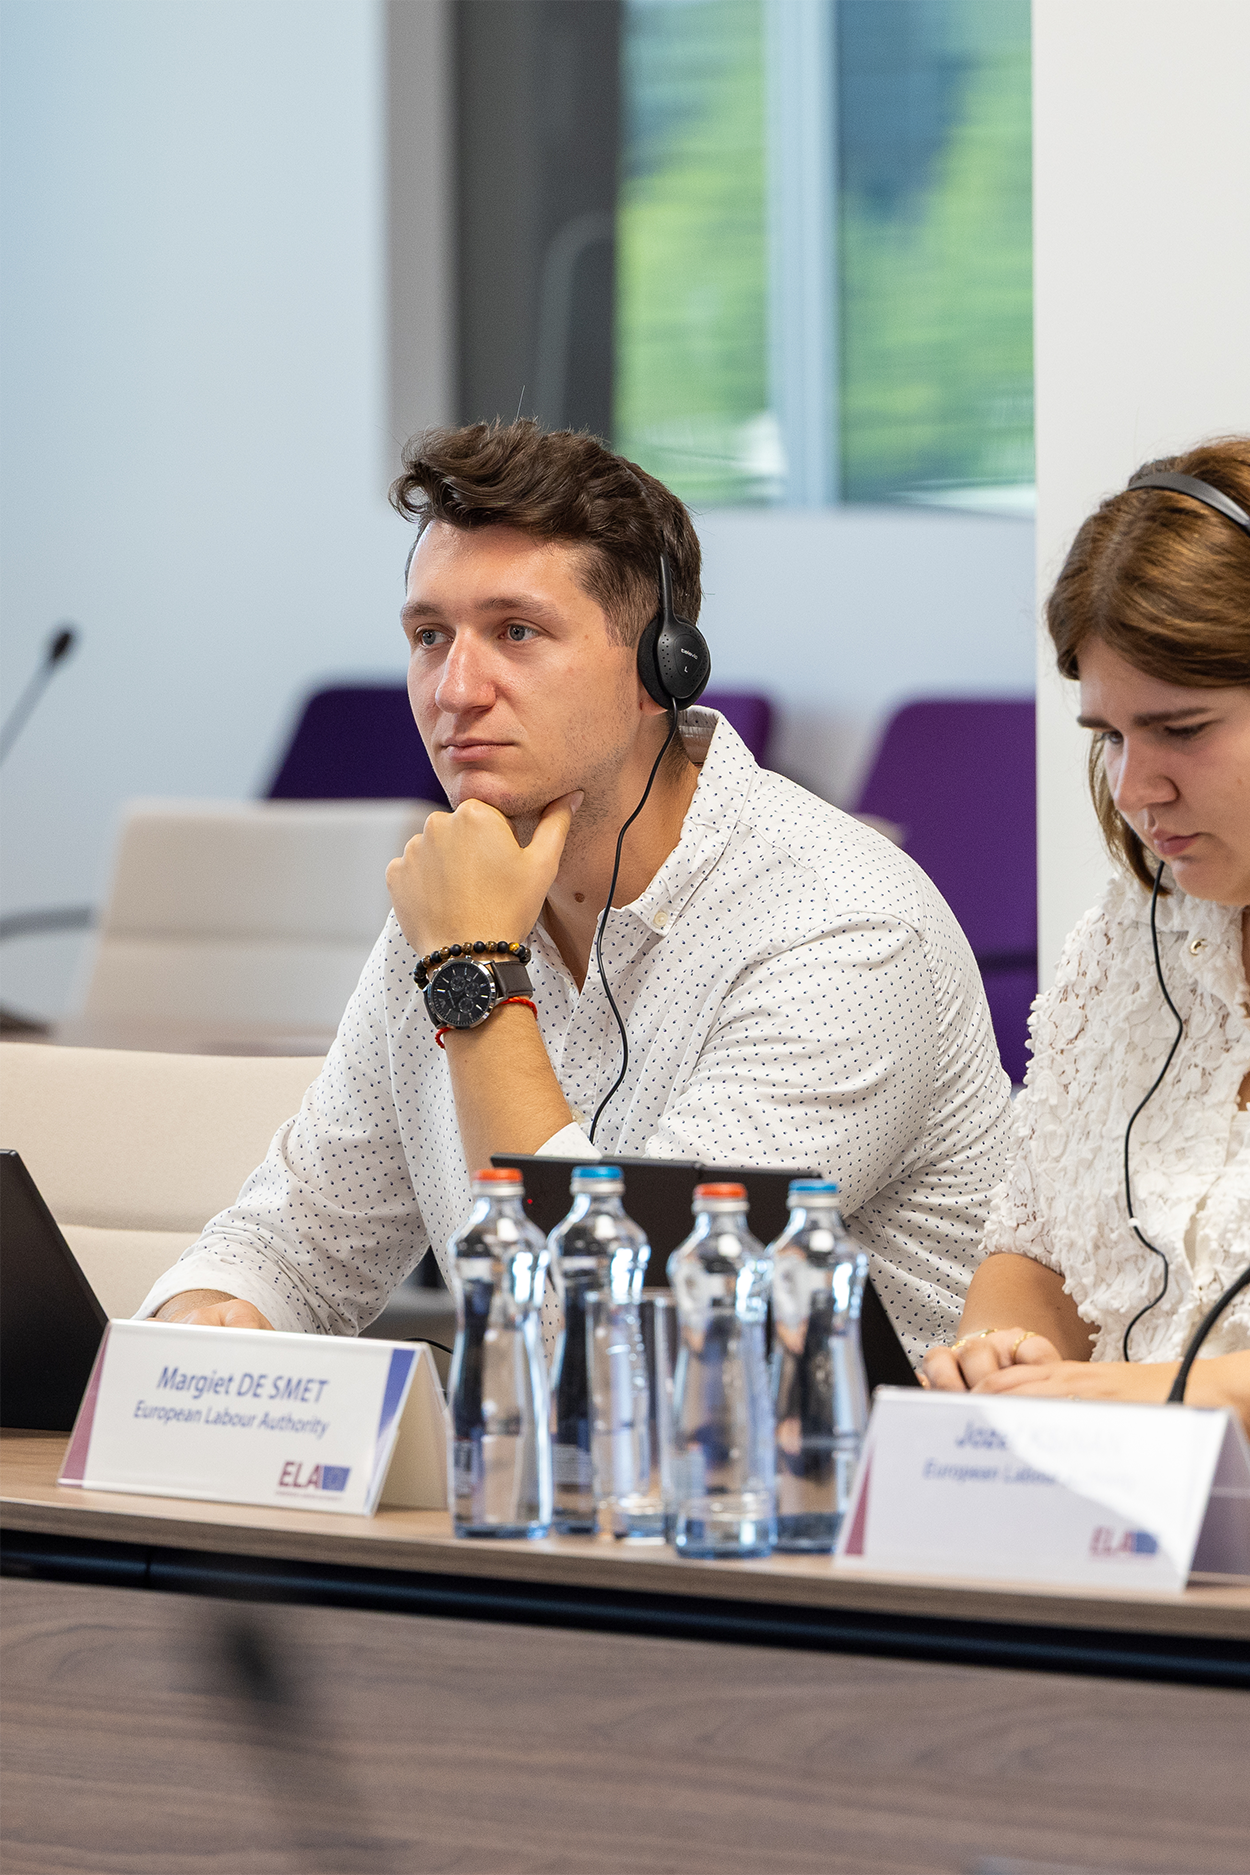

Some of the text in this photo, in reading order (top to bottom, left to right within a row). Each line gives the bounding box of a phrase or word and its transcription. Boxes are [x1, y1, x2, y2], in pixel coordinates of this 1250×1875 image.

[156, 1366, 330, 1403] Margiet DE SMET
[133, 1399, 331, 1441] European Labour Authority
[278, 1460, 322, 1489] ELA
